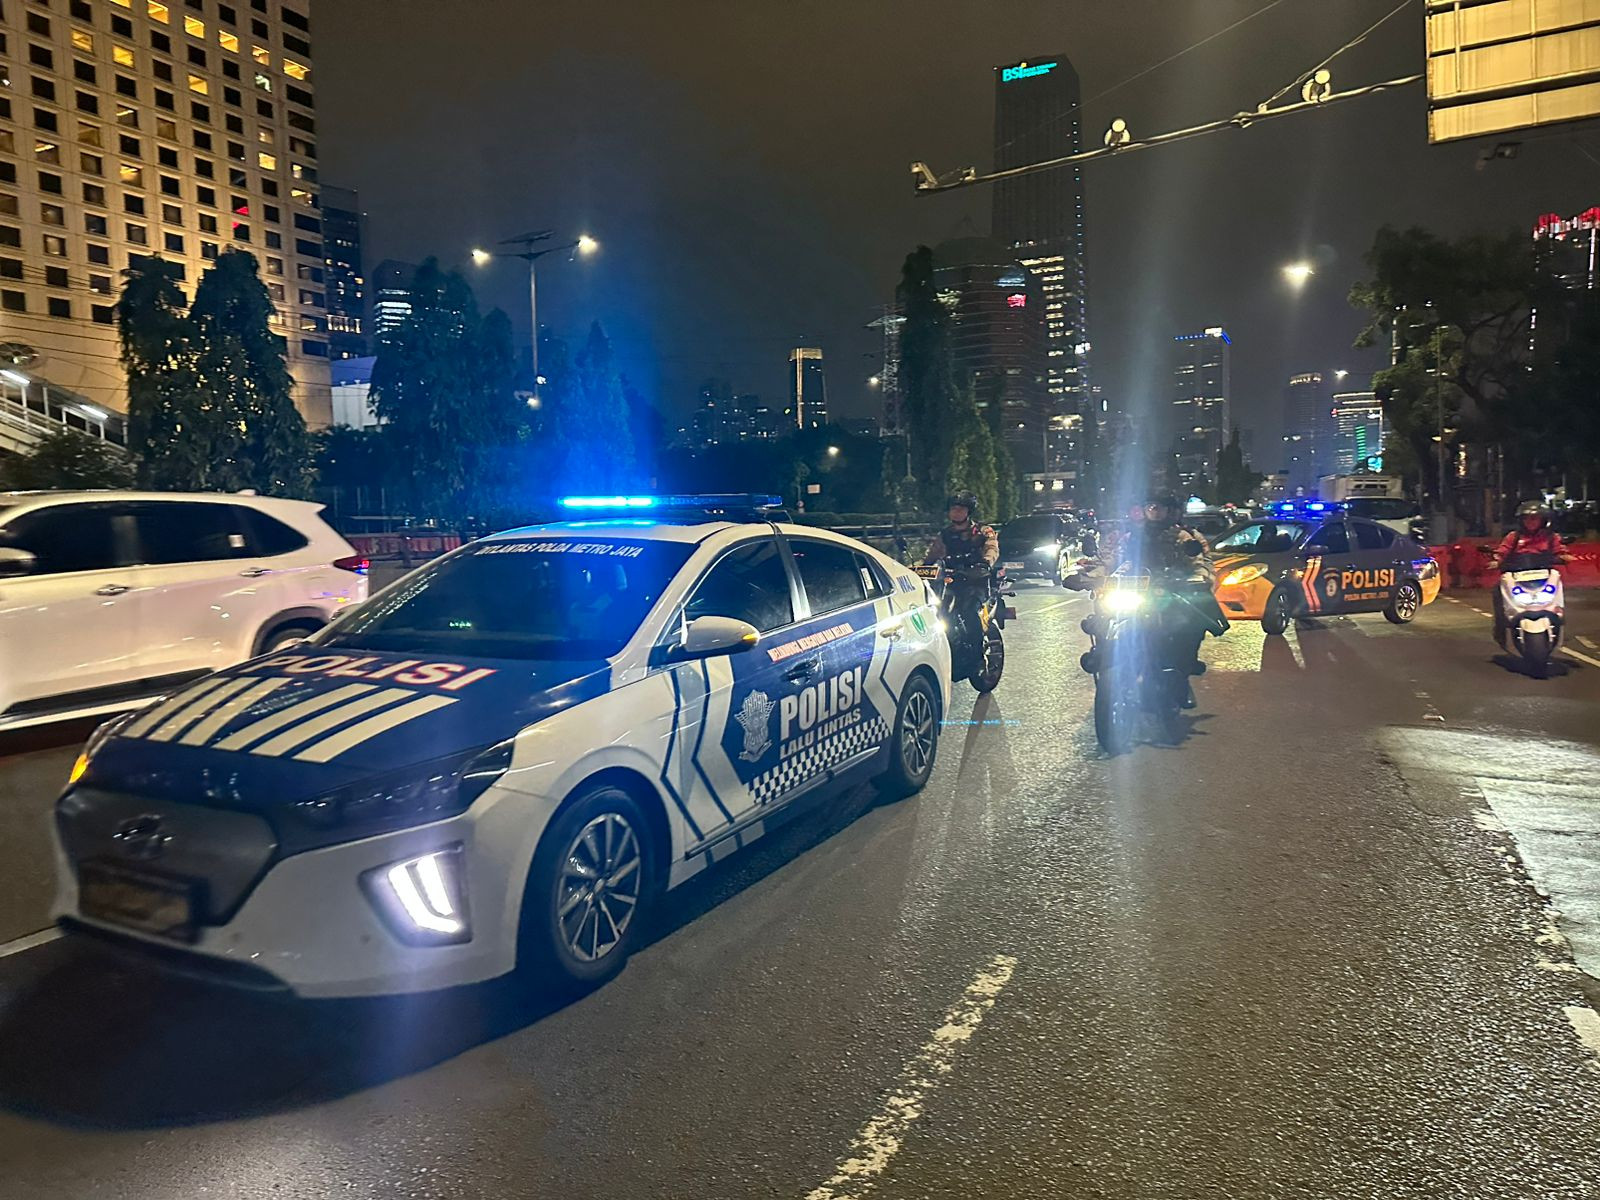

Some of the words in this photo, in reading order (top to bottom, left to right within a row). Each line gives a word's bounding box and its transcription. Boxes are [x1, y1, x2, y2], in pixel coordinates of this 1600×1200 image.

[1002, 66, 1024, 82] BSI
[530, 543, 573, 553] POLDA
[567, 543, 614, 555] METRO
[609, 545, 644, 558] JAYA
[1341, 568, 1395, 590] POLISI
[238, 655, 498, 691] POLISI
[780, 666, 862, 741] POLISI
[779, 730, 815, 760] LALU
[817, 708, 862, 741] LINTAS
